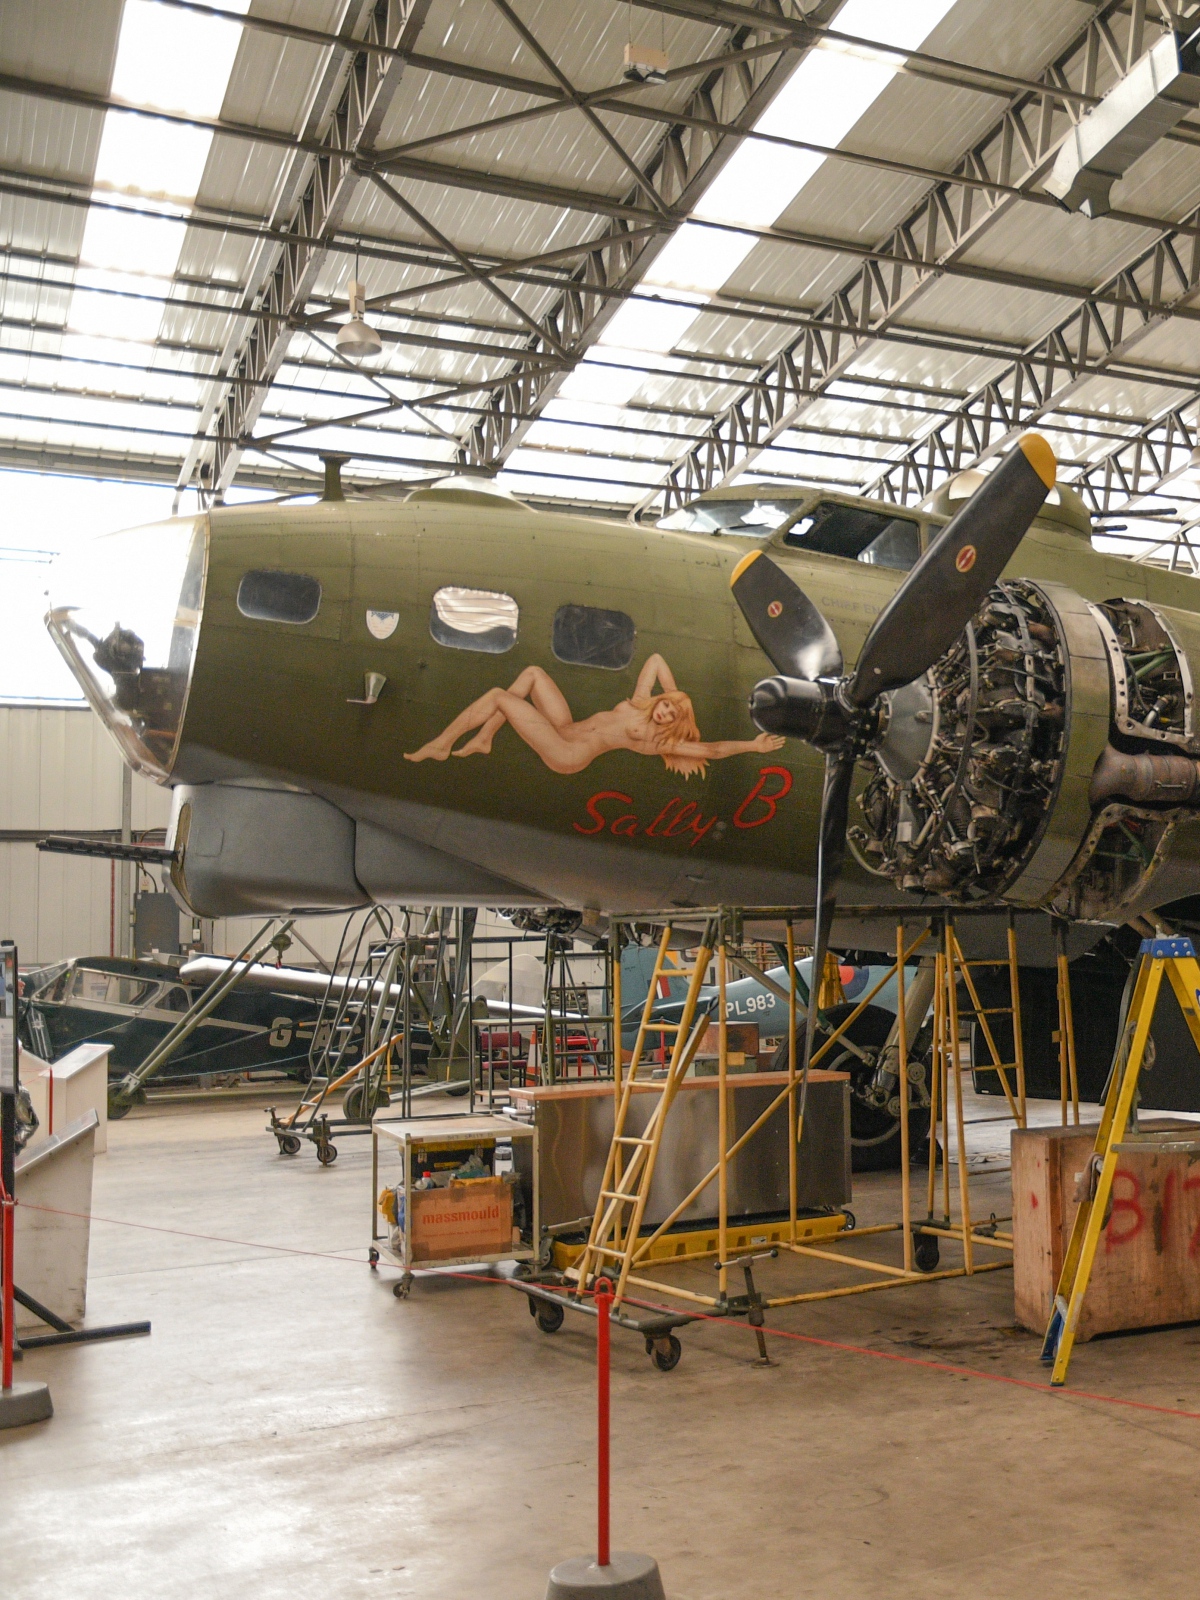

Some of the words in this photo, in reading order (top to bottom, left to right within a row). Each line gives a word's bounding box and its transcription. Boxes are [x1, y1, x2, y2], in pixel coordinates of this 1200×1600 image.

[572, 790, 718, 848] Sally
[733, 765, 793, 829] B
[725, 993, 776, 1018] PL983
[422, 1205, 500, 1225] massmould
